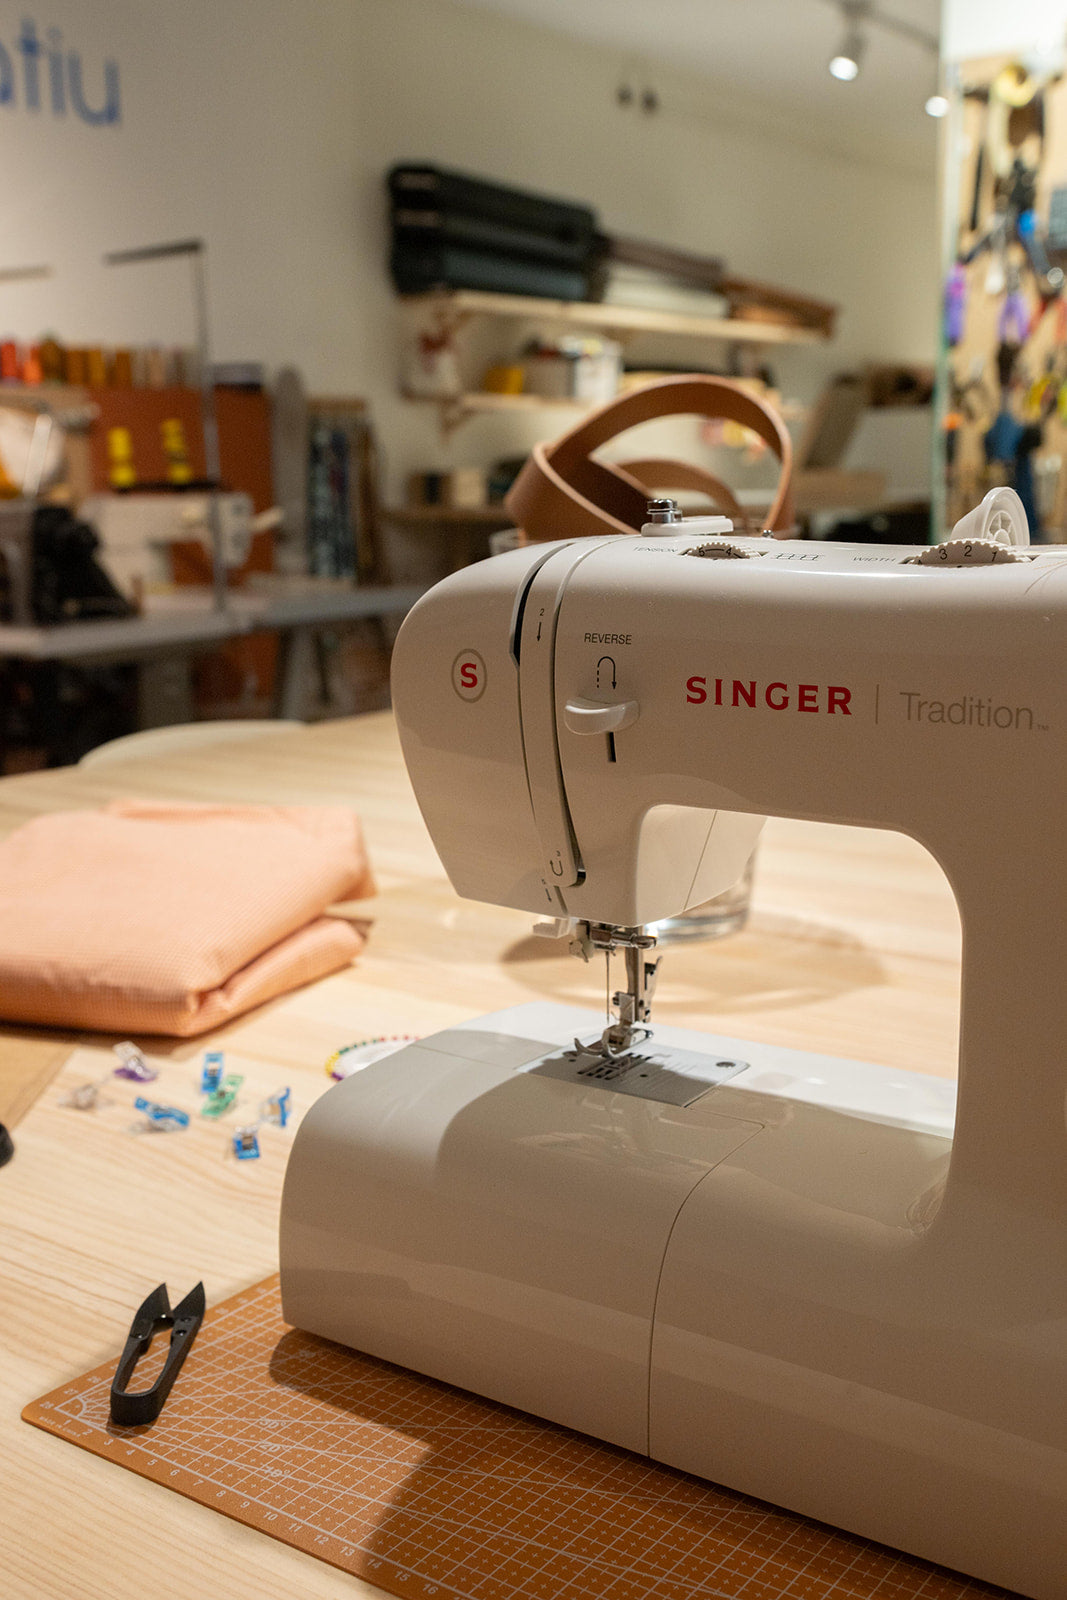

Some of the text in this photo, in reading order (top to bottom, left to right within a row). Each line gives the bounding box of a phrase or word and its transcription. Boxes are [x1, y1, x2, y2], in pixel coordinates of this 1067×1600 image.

[939, 545, 998, 562] 3 2 1
[539, 608, 545, 616] 2
[584, 632, 632, 645] REVERSE
[460, 662, 478, 688] S
[686, 676, 852, 715] SINGER
[900, 692, 1033, 730] Tradition
[82, 1428, 93, 1436] 2
[216, 1490, 226, 1498] 8
[263, 1511, 278, 1521] 10
[288, 1522, 302, 1533] 11
[314, 1534, 329, 1545] 12
[340, 1546, 355, 1557] 13
[367, 1558, 382, 1569] 14
[395, 1571, 411, 1582] 15
[422, 1583, 439, 1595] 16
